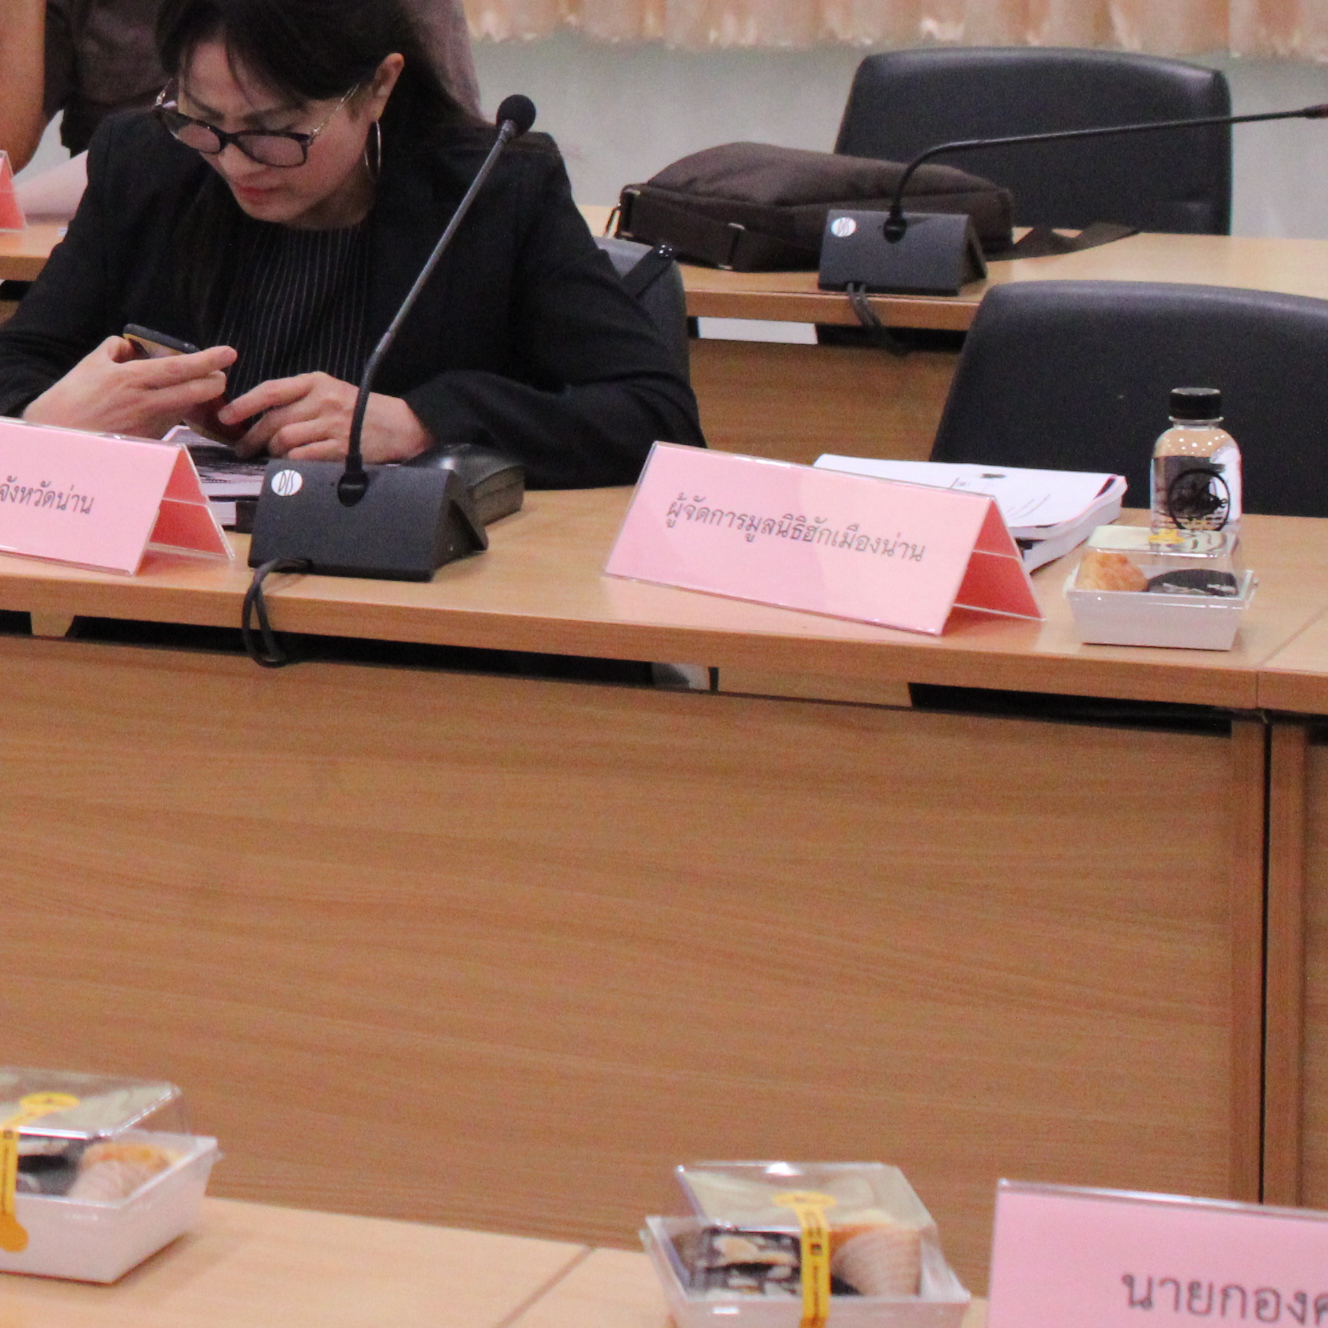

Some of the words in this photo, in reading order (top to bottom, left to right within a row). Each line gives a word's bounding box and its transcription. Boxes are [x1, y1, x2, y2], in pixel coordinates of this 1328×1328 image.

[666, 492, 927, 562] ผู้จัดการมูลนิธิฮักเมืองน่าน
